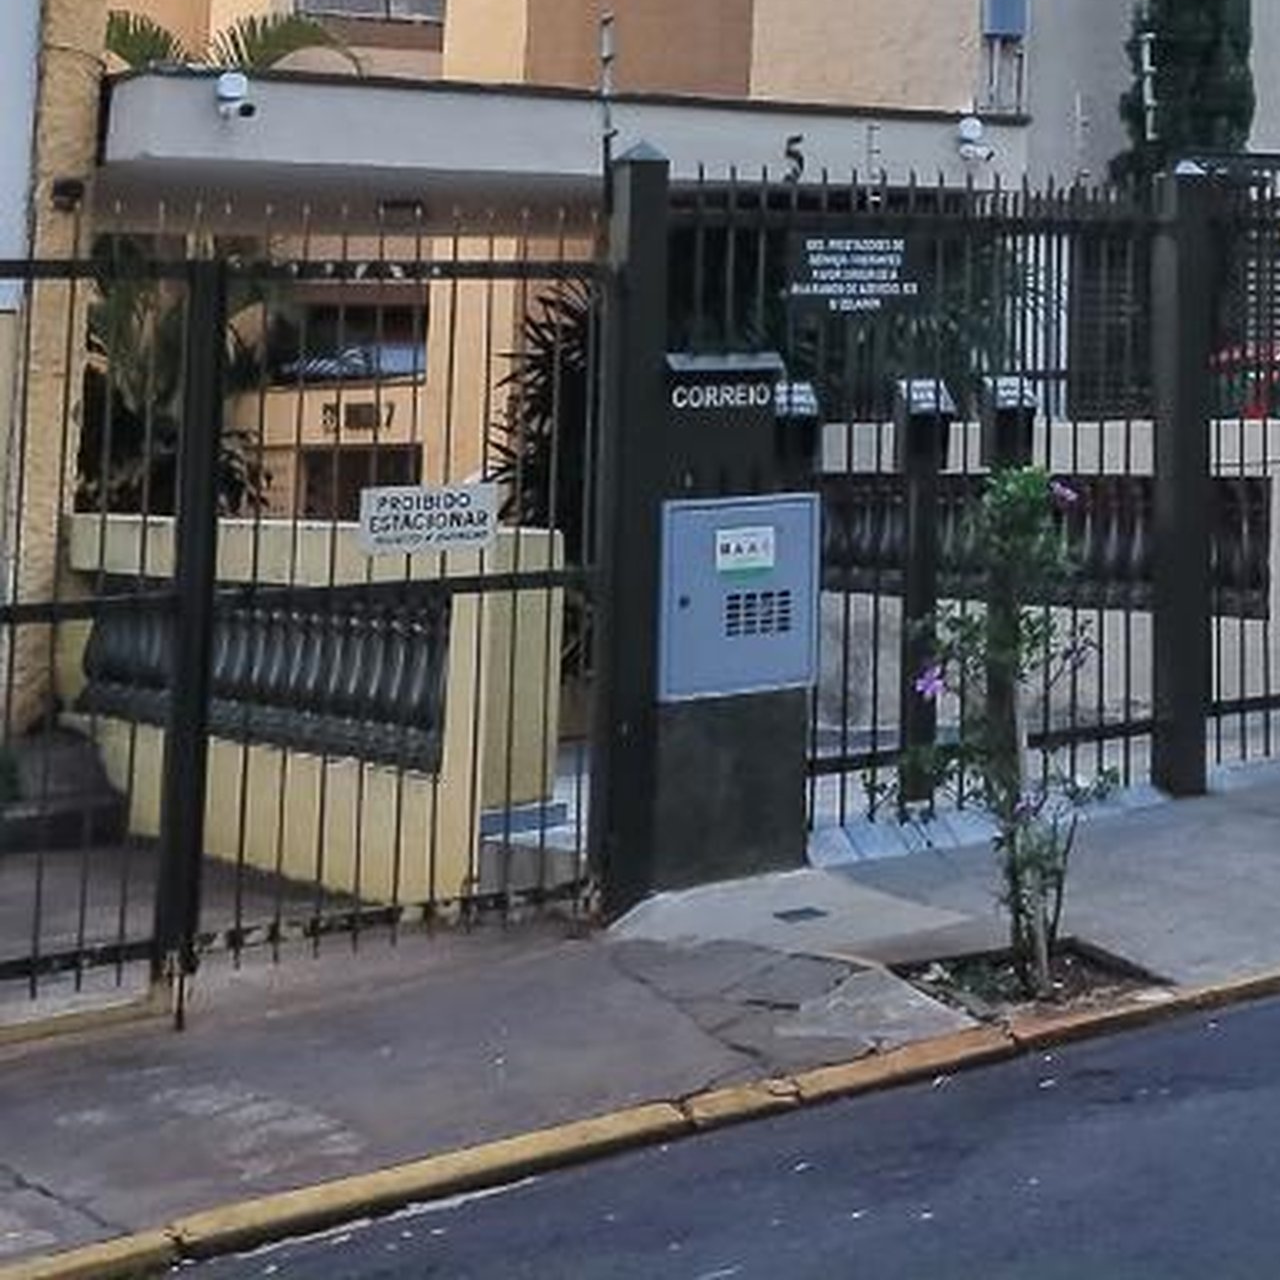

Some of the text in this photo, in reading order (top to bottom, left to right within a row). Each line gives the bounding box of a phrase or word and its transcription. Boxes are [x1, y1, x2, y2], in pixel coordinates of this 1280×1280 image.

[784, 133, 804, 182] 5
[671, 381, 770, 409] CORREIO
[376, 492, 472, 512] PROIBIDO
[369, 510, 489, 534] ESTACIONAR
